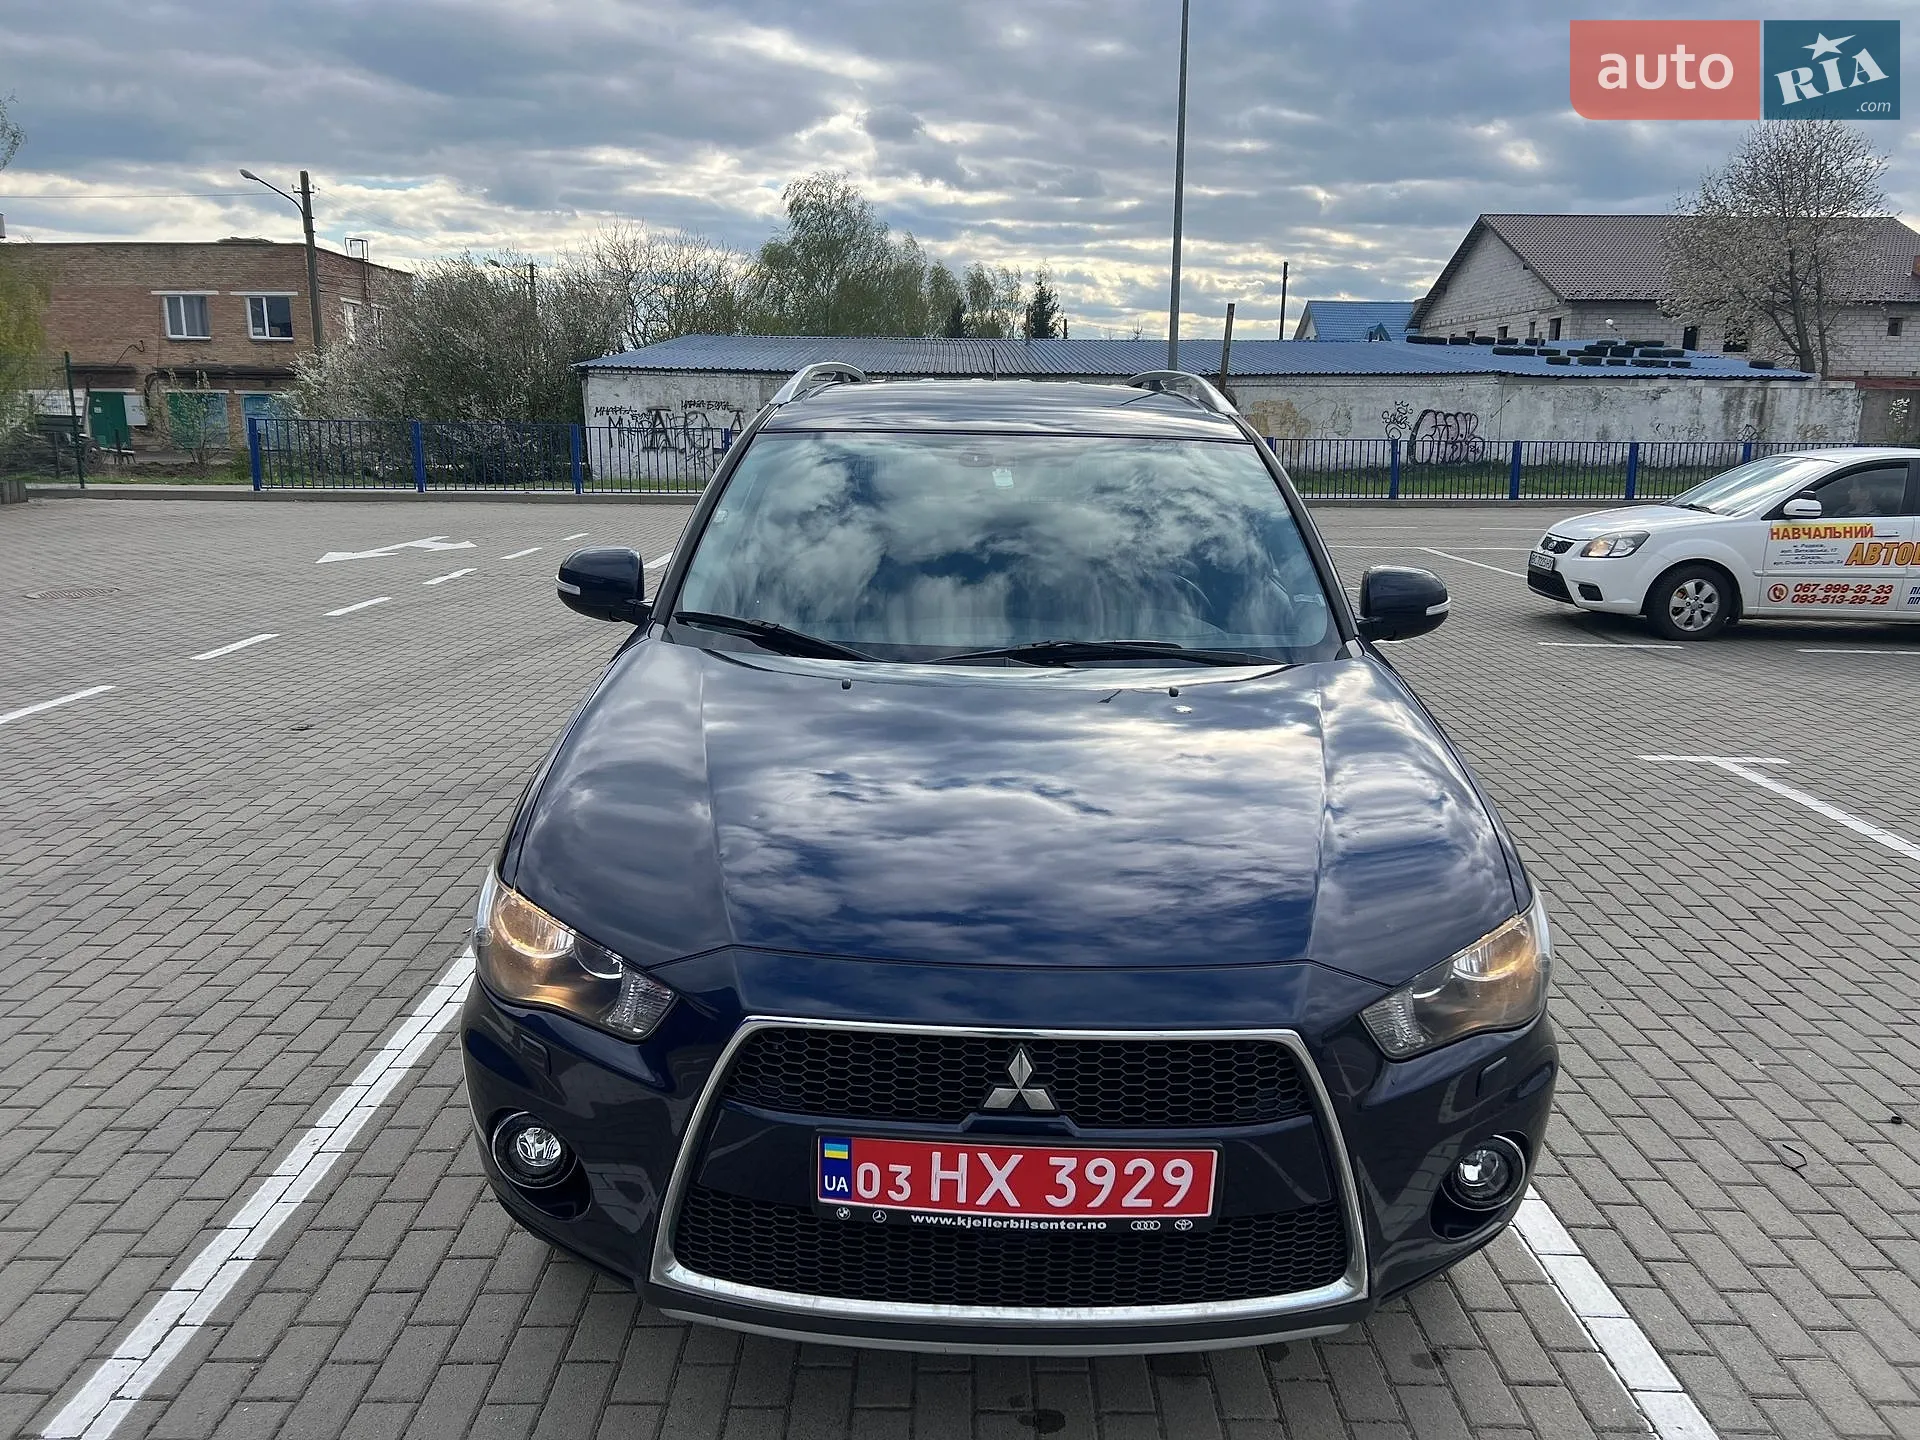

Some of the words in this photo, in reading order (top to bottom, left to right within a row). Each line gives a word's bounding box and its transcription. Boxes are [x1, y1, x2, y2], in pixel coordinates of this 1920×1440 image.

[1770, 523, 1874, 540] НАВЧАЛЬНИЙ
[1793, 583, 1894, 595] 067-999-32-33
[1791, 594, 1890, 605] 093-513-29-22
[824, 1174, 849, 1193] UA
[856, 1162, 912, 1201] 03
[930, 1151, 1025, 1208] HX
[1044, 1156, 1195, 1209] 3929
[910, 1213, 1108, 1232] www.kjellerbilsenter.no
